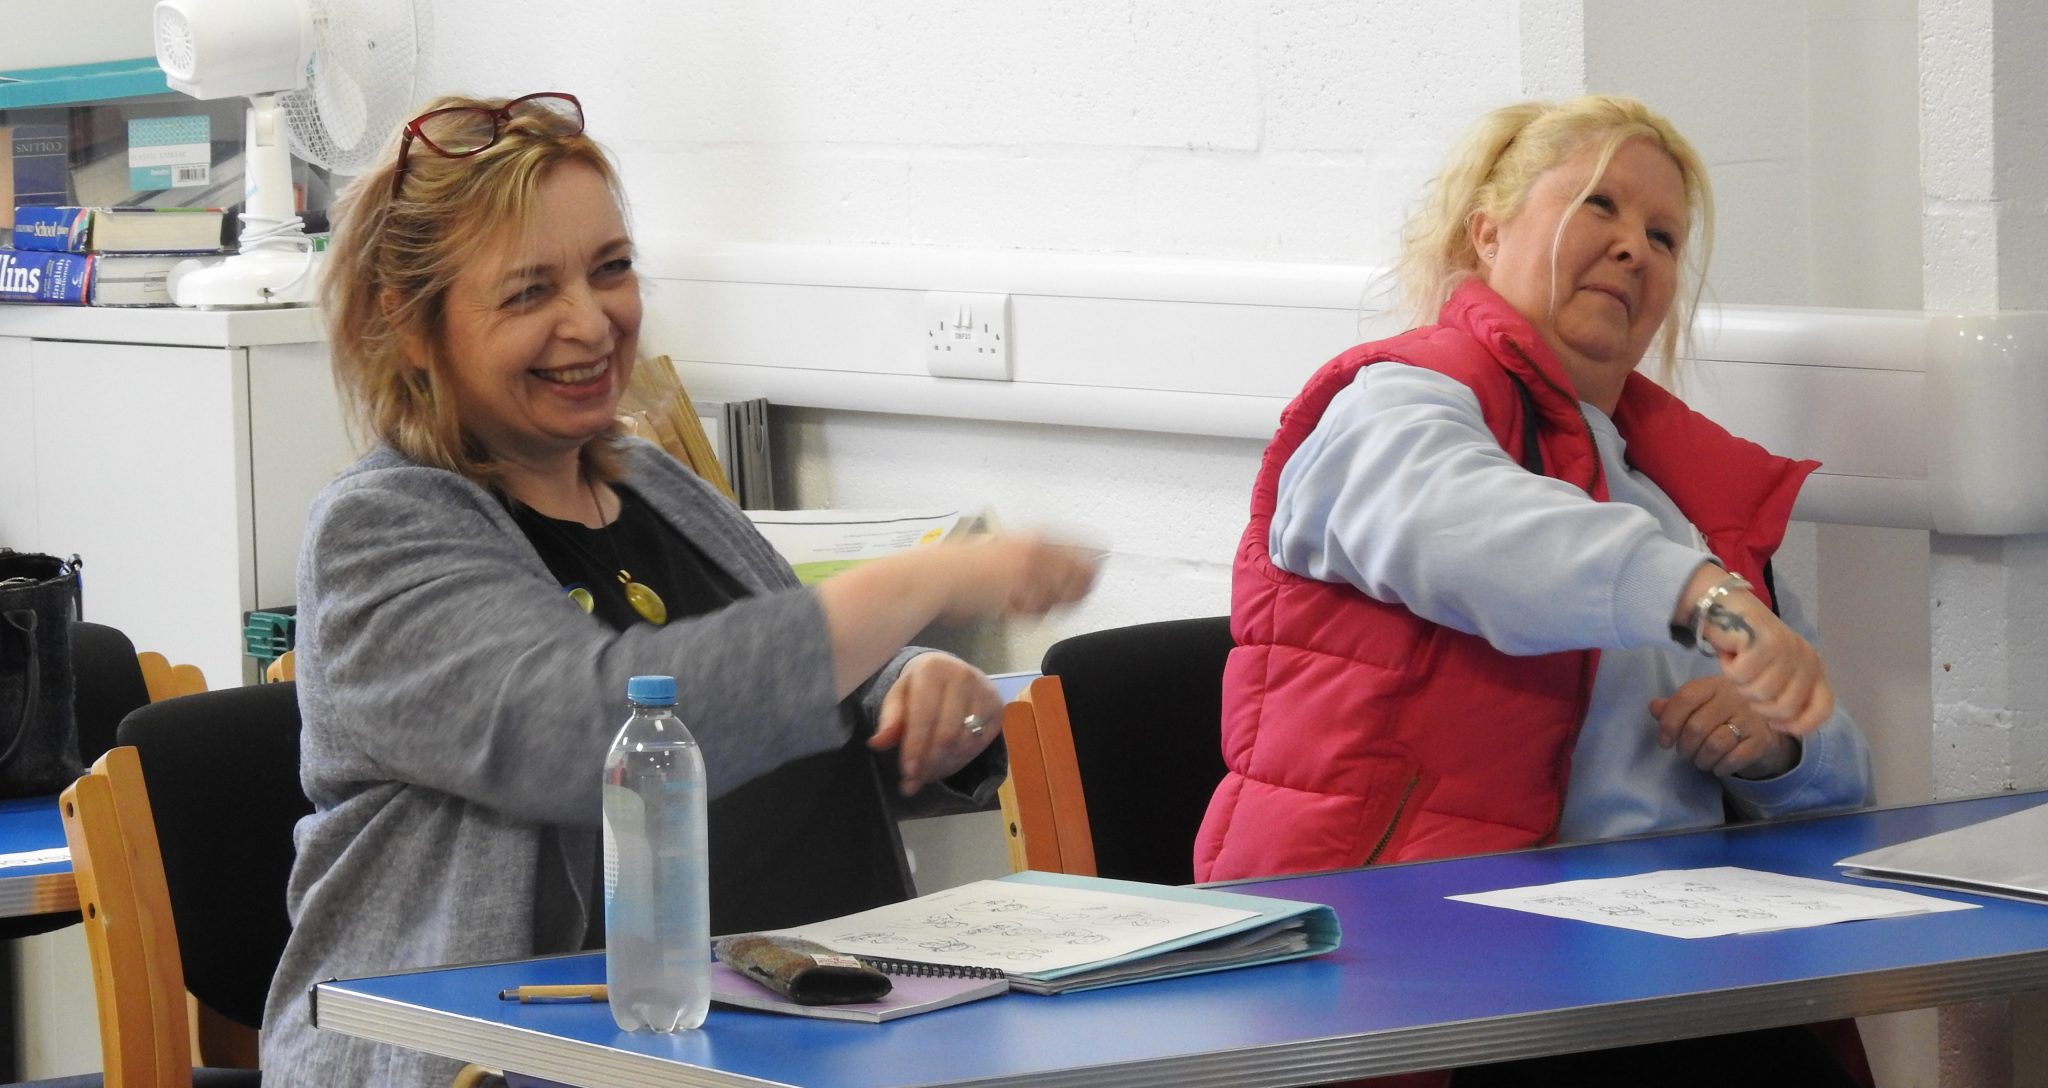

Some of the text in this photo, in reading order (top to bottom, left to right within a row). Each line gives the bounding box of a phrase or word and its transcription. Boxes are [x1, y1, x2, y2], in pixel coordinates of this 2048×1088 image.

[15, 142, 63, 153] COLLINS
[34, 221, 57, 237] School
[52, 259, 65, 299] English
[60, 259, 72, 299] Dictionary
